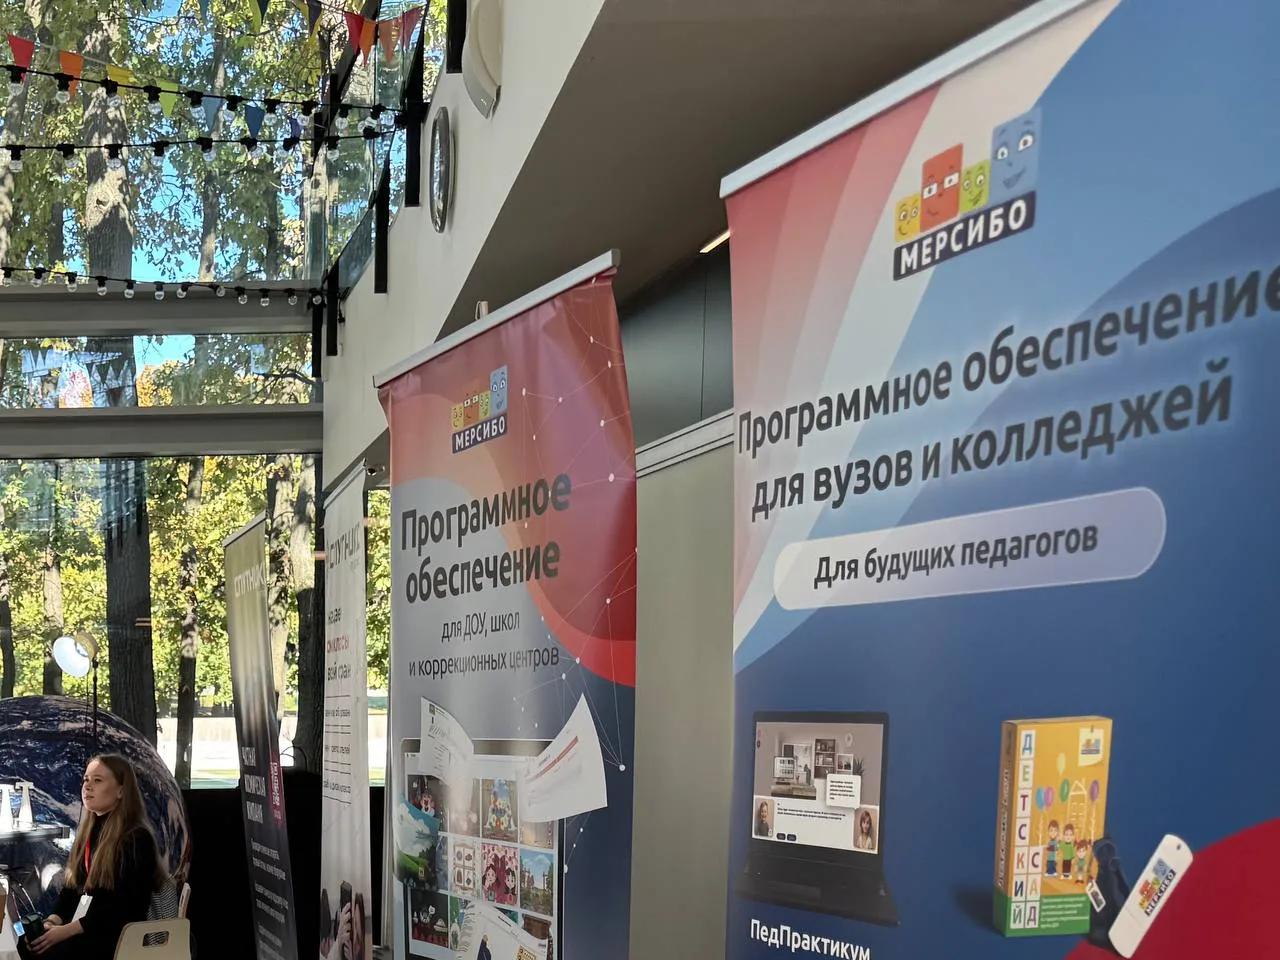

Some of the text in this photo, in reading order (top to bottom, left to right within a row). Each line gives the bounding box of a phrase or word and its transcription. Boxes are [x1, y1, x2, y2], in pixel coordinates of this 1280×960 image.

[900, 199, 1028, 275] МЕРСИБО
[455, 416, 506, 452] МЕРСИБО
[738, 361, 952, 455] Программное
[752, 357, 1233, 521] для вузов и колледжей
[402, 473, 571, 556] Программное
[407, 541, 560, 603] обеспечение
[814, 524, 1098, 589] Для будущих педагогов
[441, 611, 520, 642] для ДОУ, школ
[409, 646, 559, 678] и коррекционных центров
[1143, 868, 1177, 918] МЕРСИБО
